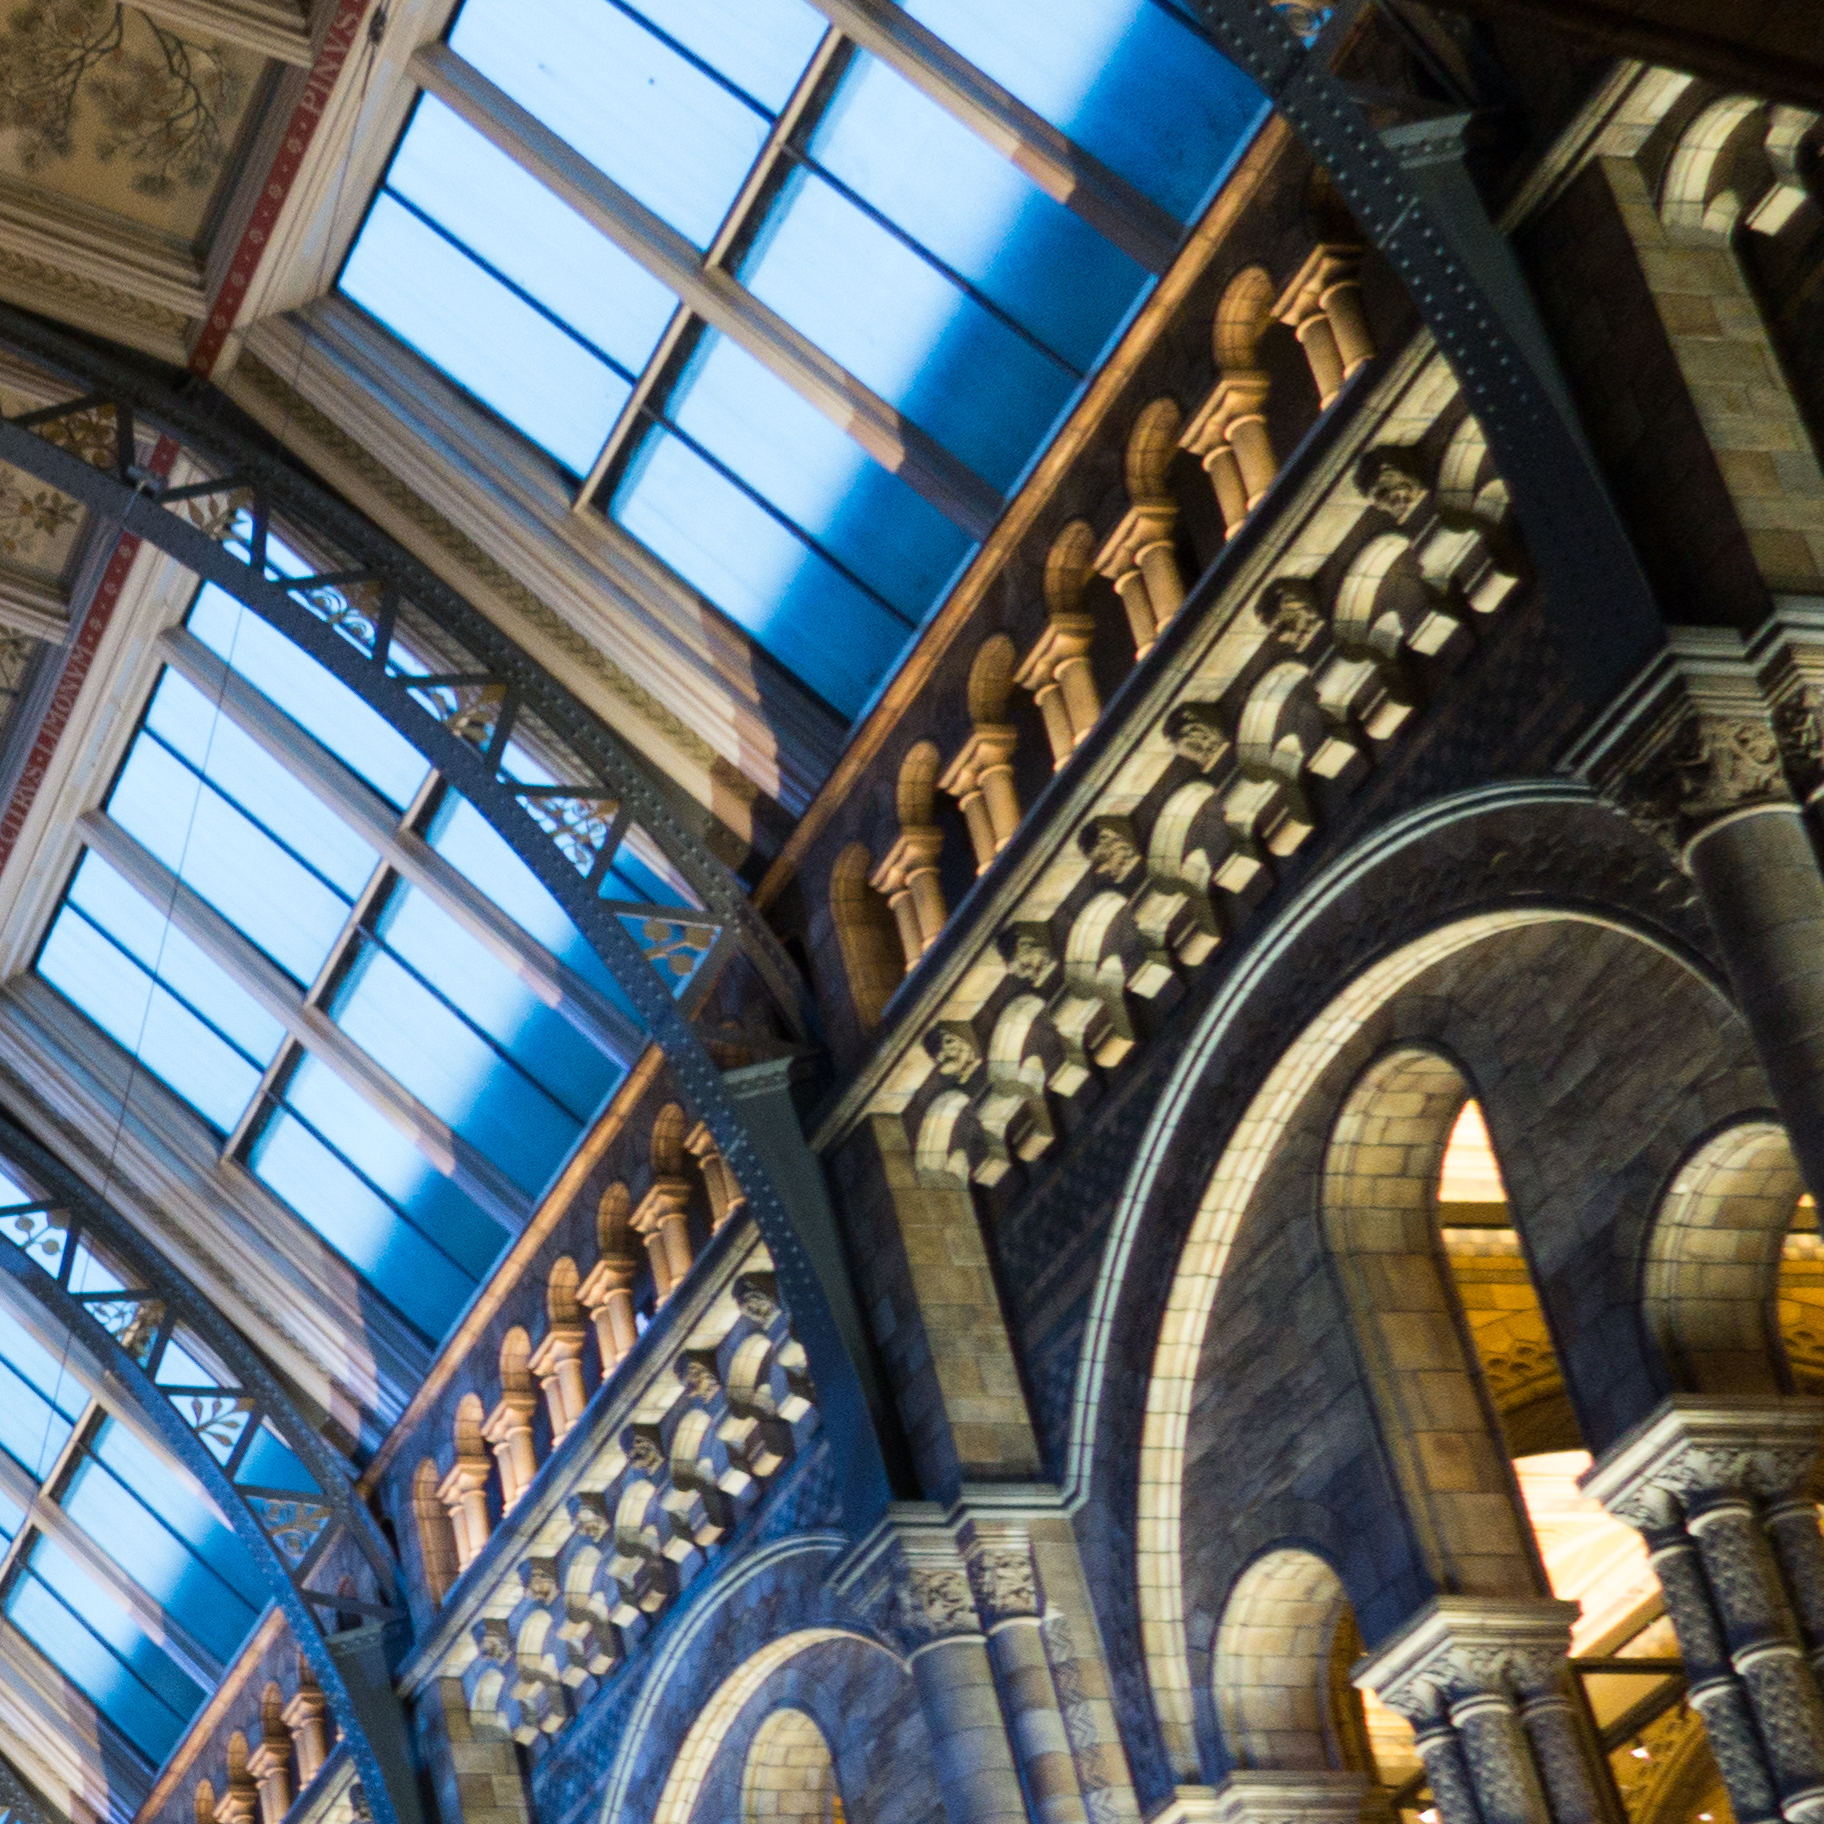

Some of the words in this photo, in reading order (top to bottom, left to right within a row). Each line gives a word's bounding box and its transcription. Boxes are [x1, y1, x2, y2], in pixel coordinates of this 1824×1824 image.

[299, 12, 358, 114] PINVS
[0, 763, 44, 849] CITRVS
[33, 644, 94, 755] LIMONVM
